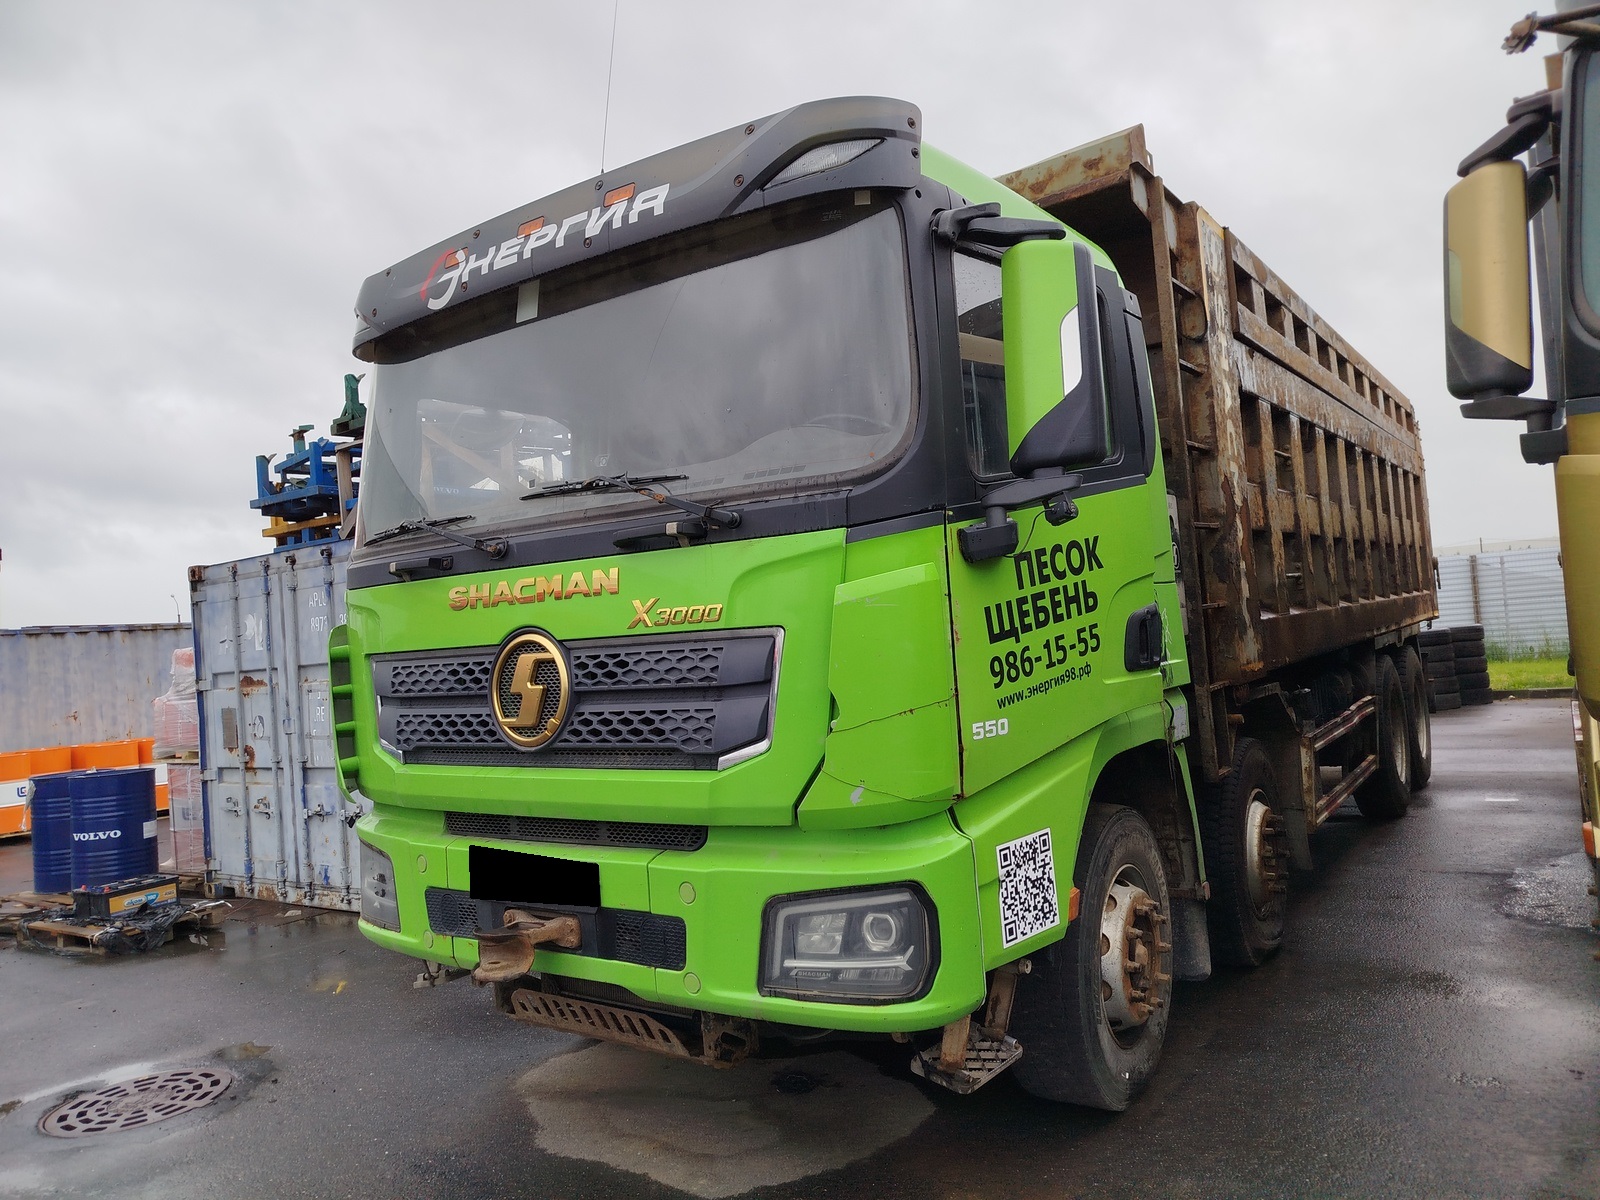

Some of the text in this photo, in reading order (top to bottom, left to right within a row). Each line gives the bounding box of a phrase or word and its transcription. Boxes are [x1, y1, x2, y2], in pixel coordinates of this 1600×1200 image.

[420, 183, 670, 310] ЭНЕРГИЯ
[1013, 535, 1105, 591] ПЕСОК
[448, 567, 620, 611] SHACMAN
[626, 597, 723, 630] X3000
[983, 579, 1099, 645] ЩЕБЕНЬ
[989, 623, 1101, 690] 986-15-55
[997, 661, 1092, 710] www.энергия98.рф
[972, 718, 1009, 741] 550
[72, 829, 122, 841] VOLVO
